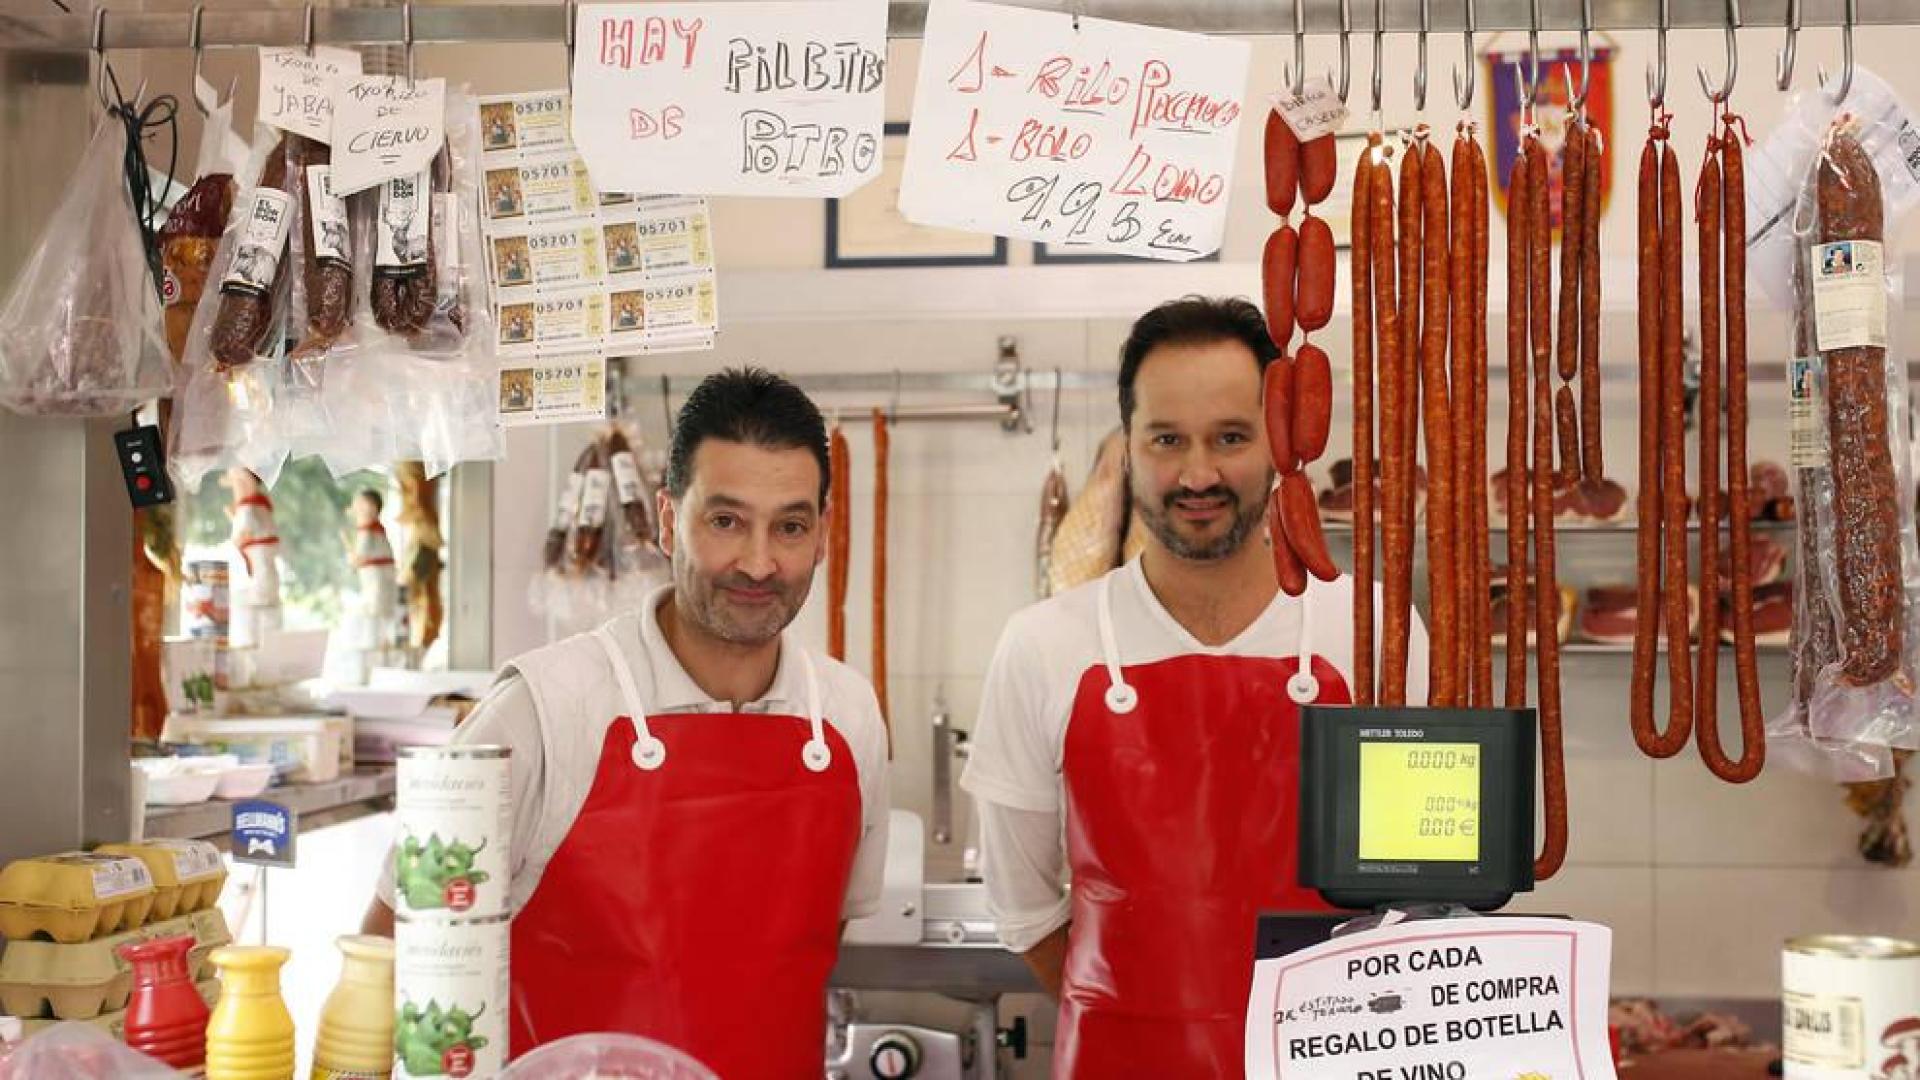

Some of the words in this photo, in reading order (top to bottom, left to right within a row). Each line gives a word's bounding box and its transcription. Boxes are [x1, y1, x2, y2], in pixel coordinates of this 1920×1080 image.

[600, 16, 703, 69] HAY
[272, 85, 335, 117] JABA
[376, 105, 402, 118] DE
[515, 98, 563, 115] 05701
[628, 105, 685, 140] DE
[348, 126, 430, 154] CIERVO
[740, 109, 876, 176] POTRO
[521, 163, 569, 181] 05701
[1109, 143, 1225, 205] LOMO
[639, 219, 687, 236] 05701
[529, 233, 578, 249] 05701
[645, 286, 694, 302] 05701
[536, 299, 584, 314] 05701
[534, 366, 583, 381] 05701
[1459, 819, 1476, 837] €
[1347, 953, 1401, 980] POR
[1408, 945, 1483, 973] CADA
[1430, 983, 1460, 1007] DE
[1465, 975, 1560, 1002] COMPRA
[1289, 1027, 1397, 1060] REGALO
[1404, 1022, 1440, 1048] DE
[1446, 1009, 1564, 1043] BOTELLA
